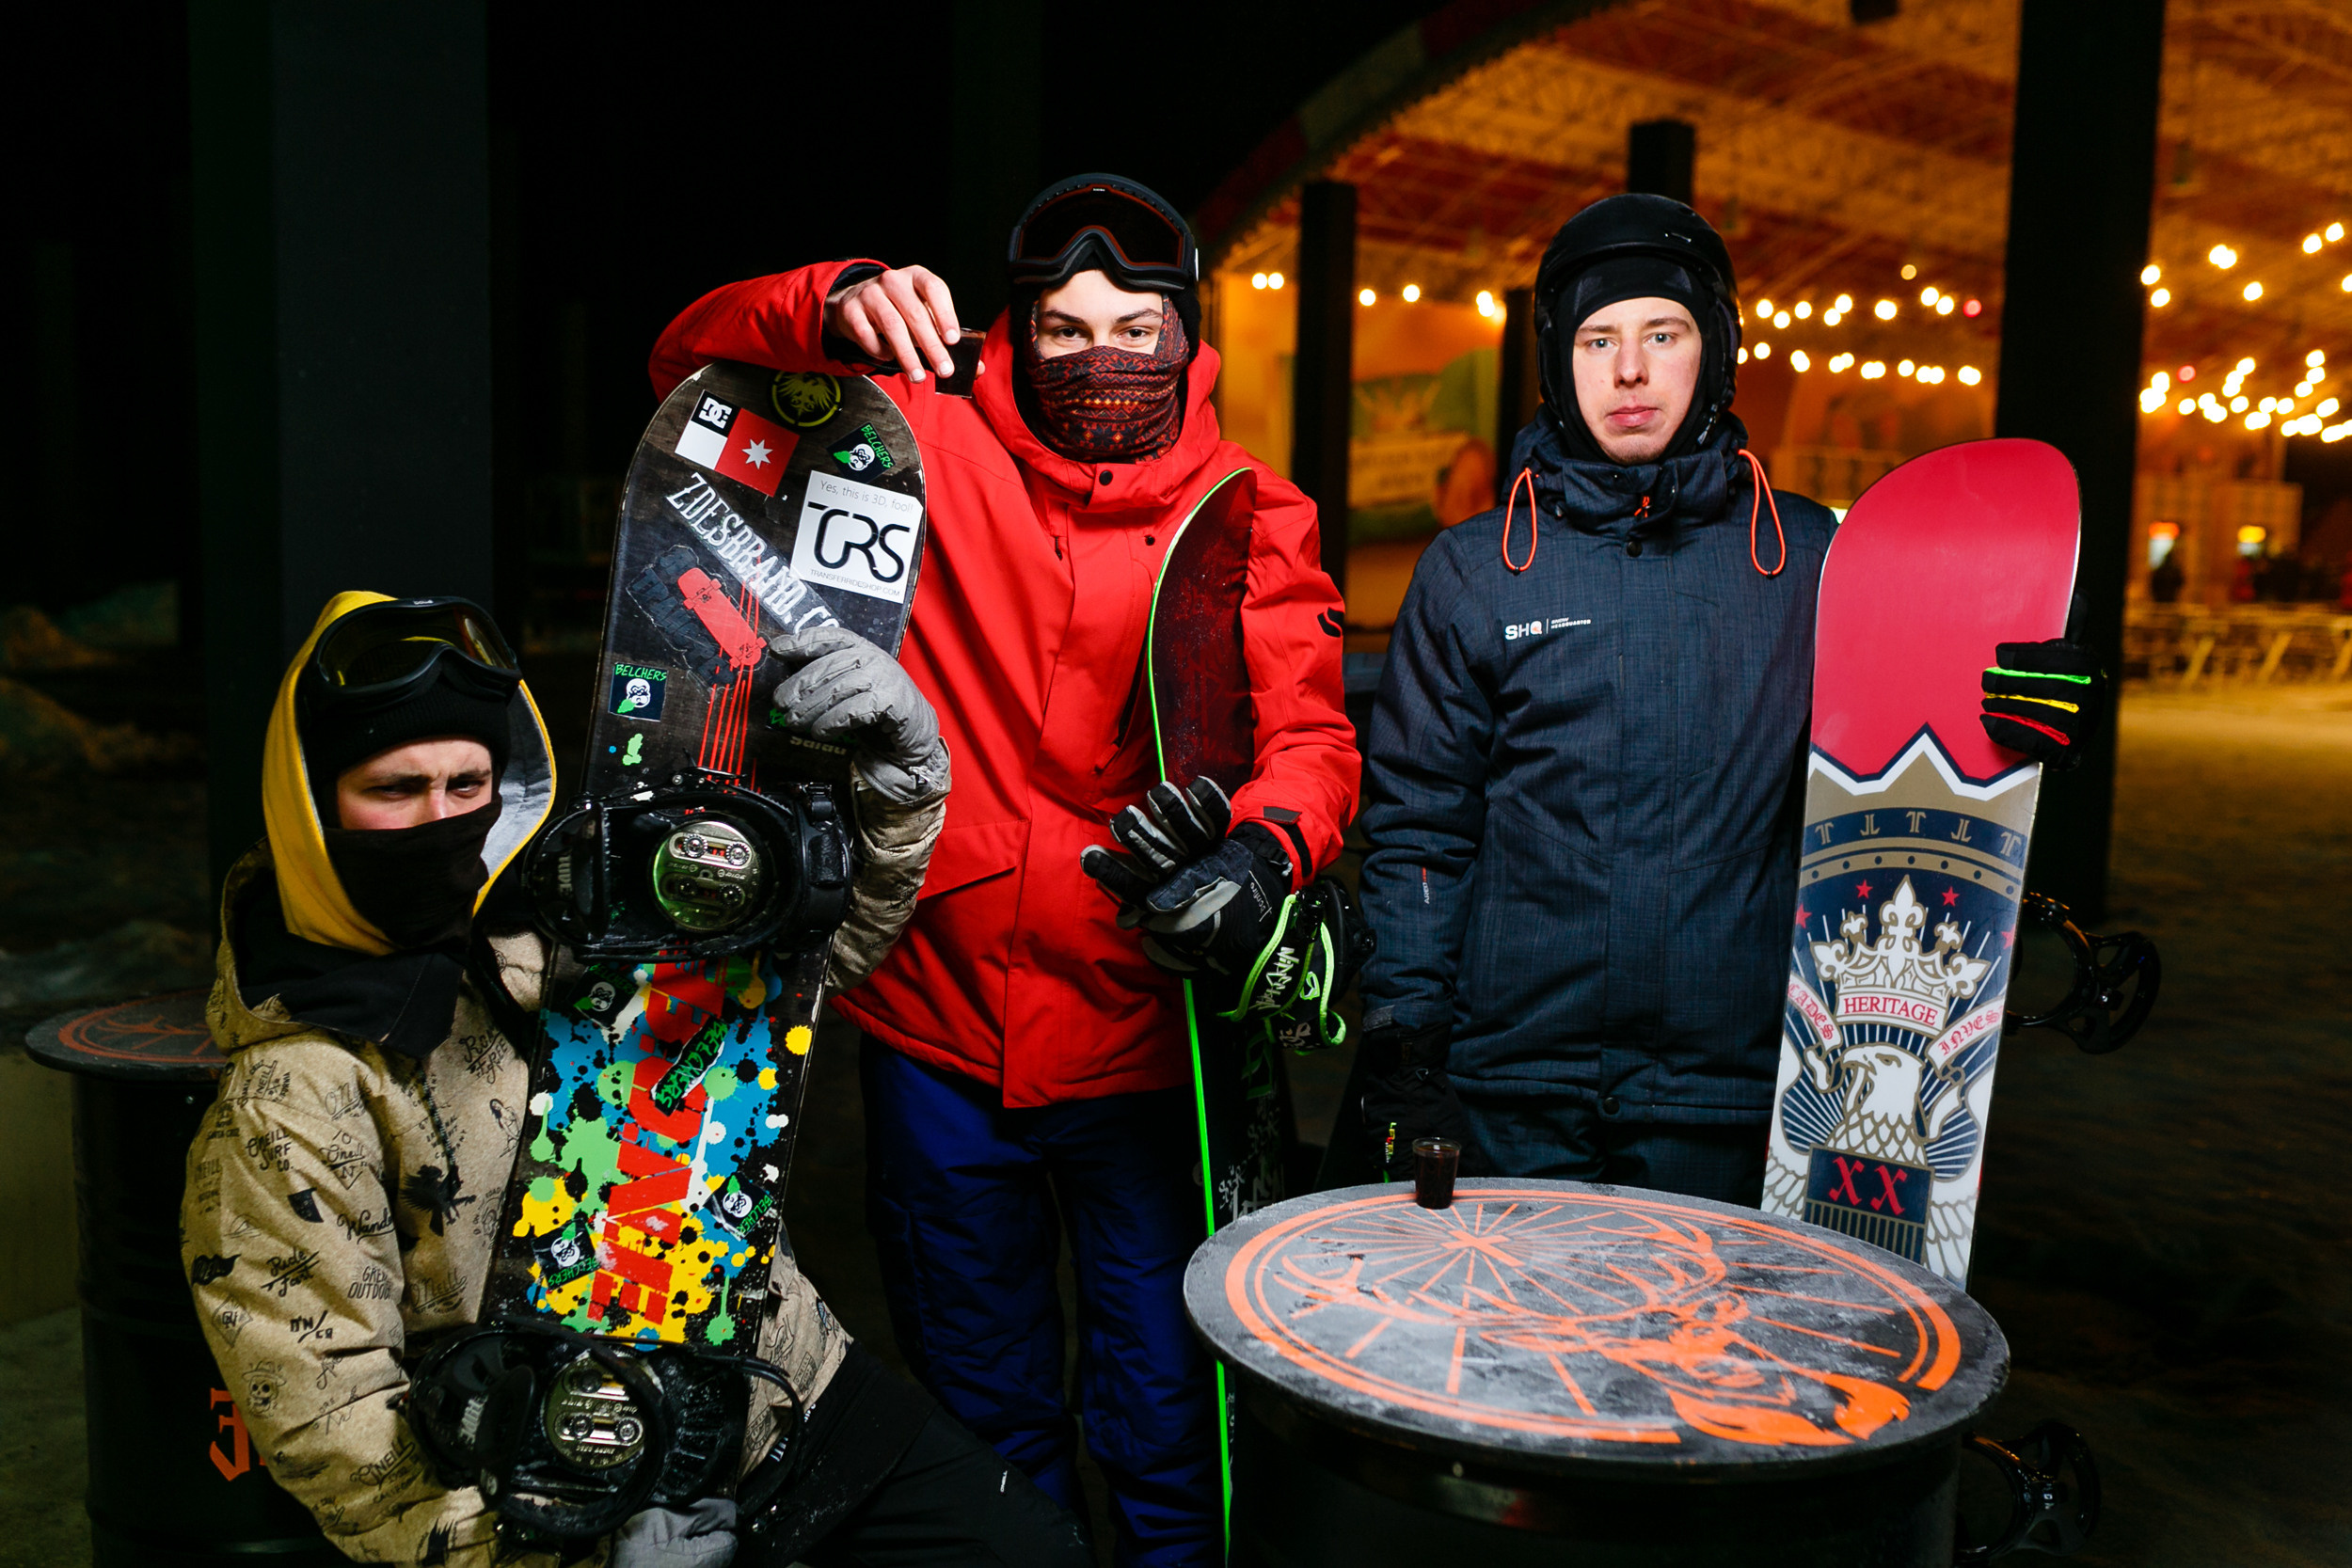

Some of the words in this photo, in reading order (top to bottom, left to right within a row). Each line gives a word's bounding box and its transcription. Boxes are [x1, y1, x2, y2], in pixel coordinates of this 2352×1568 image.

[860, 424, 895, 470] BELCHERS
[820, 480, 839, 497] Yes,
[842, 485, 860, 500] this
[861, 488, 870, 501] is
[872, 491, 890, 509] 3D,
[891, 495, 914, 513] fool!
[1505, 620, 1543, 641] SHQ
[614, 663, 667, 682] BELCHERS
[1843, 996, 1938, 1026] HERITAGE
[260, 1142, 293, 1172] SURF
